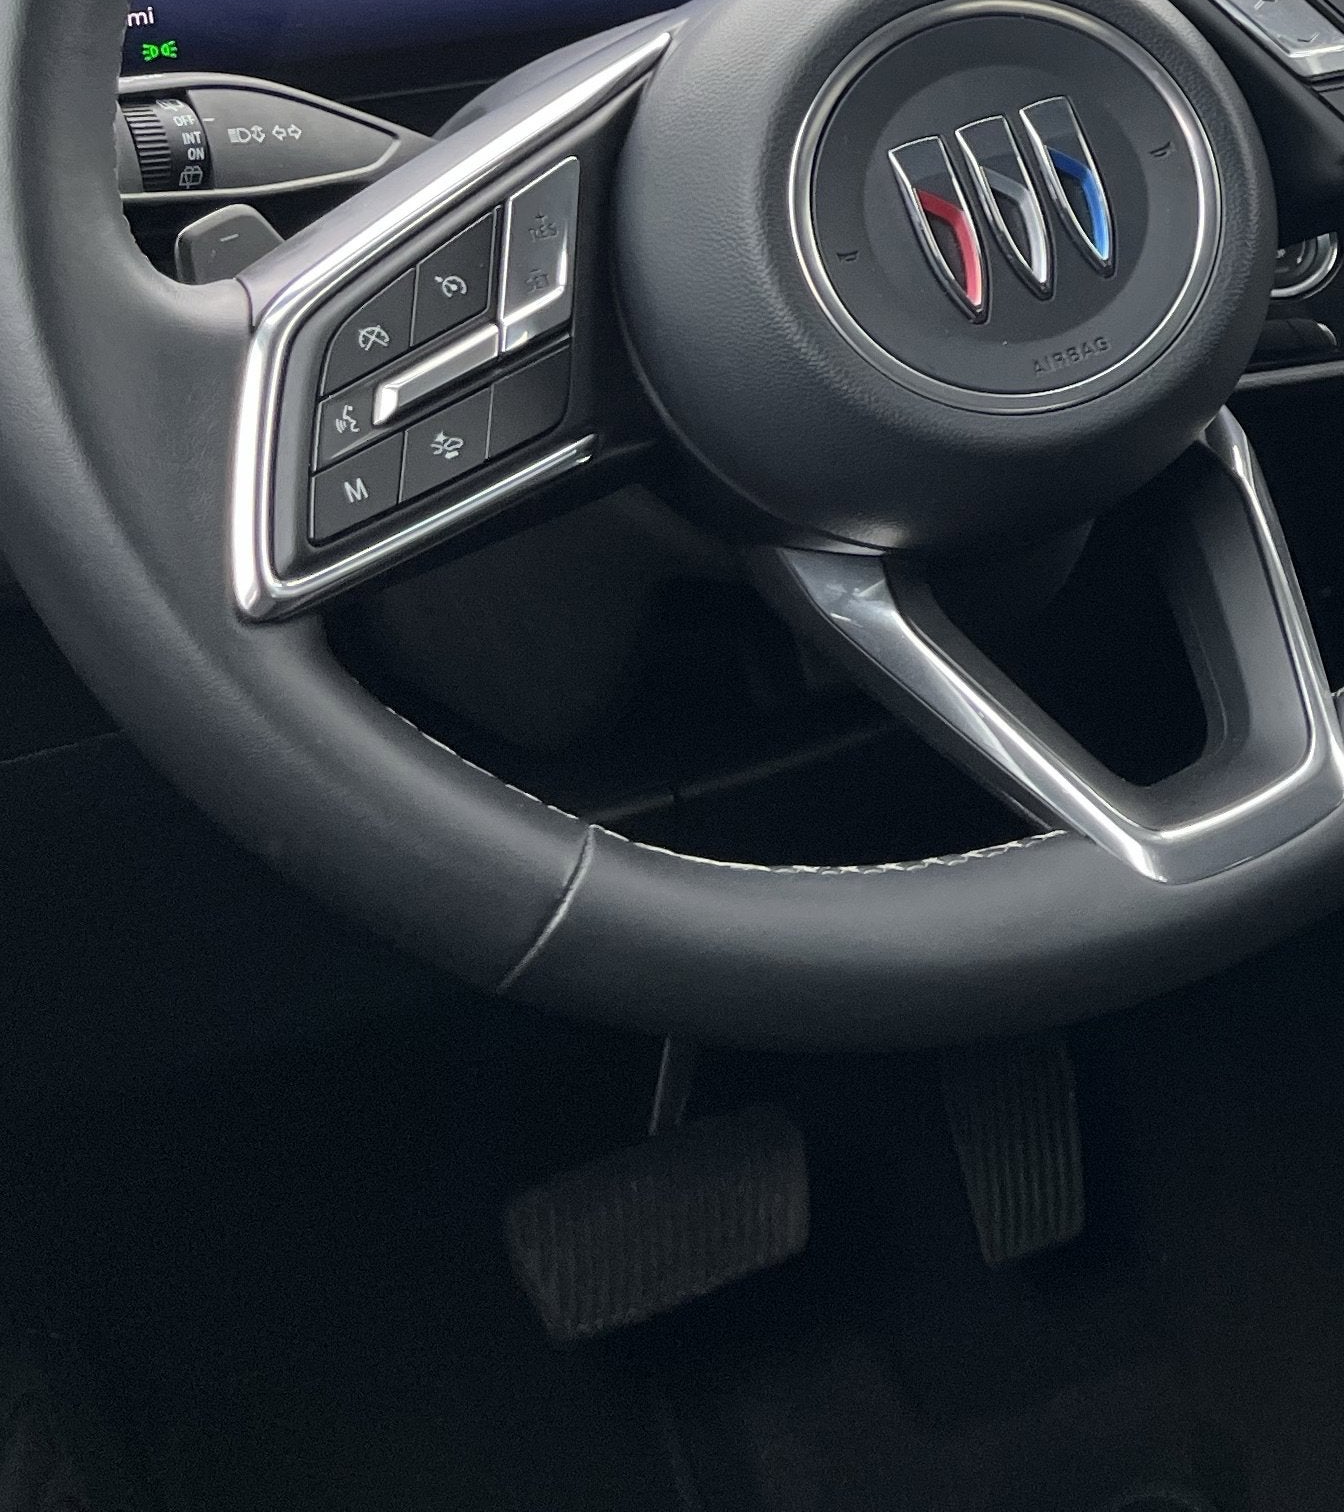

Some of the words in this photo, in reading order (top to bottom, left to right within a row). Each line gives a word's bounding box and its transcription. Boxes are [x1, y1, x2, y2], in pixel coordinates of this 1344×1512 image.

[127, 6, 155, 27] mi
[172, 114, 196, 127] OFF
[182, 131, 201, 145] INT
[187, 147, 205, 161] ON
[1034, 335, 1110, 374] AIRBAG
[344, 477, 369, 503] M
